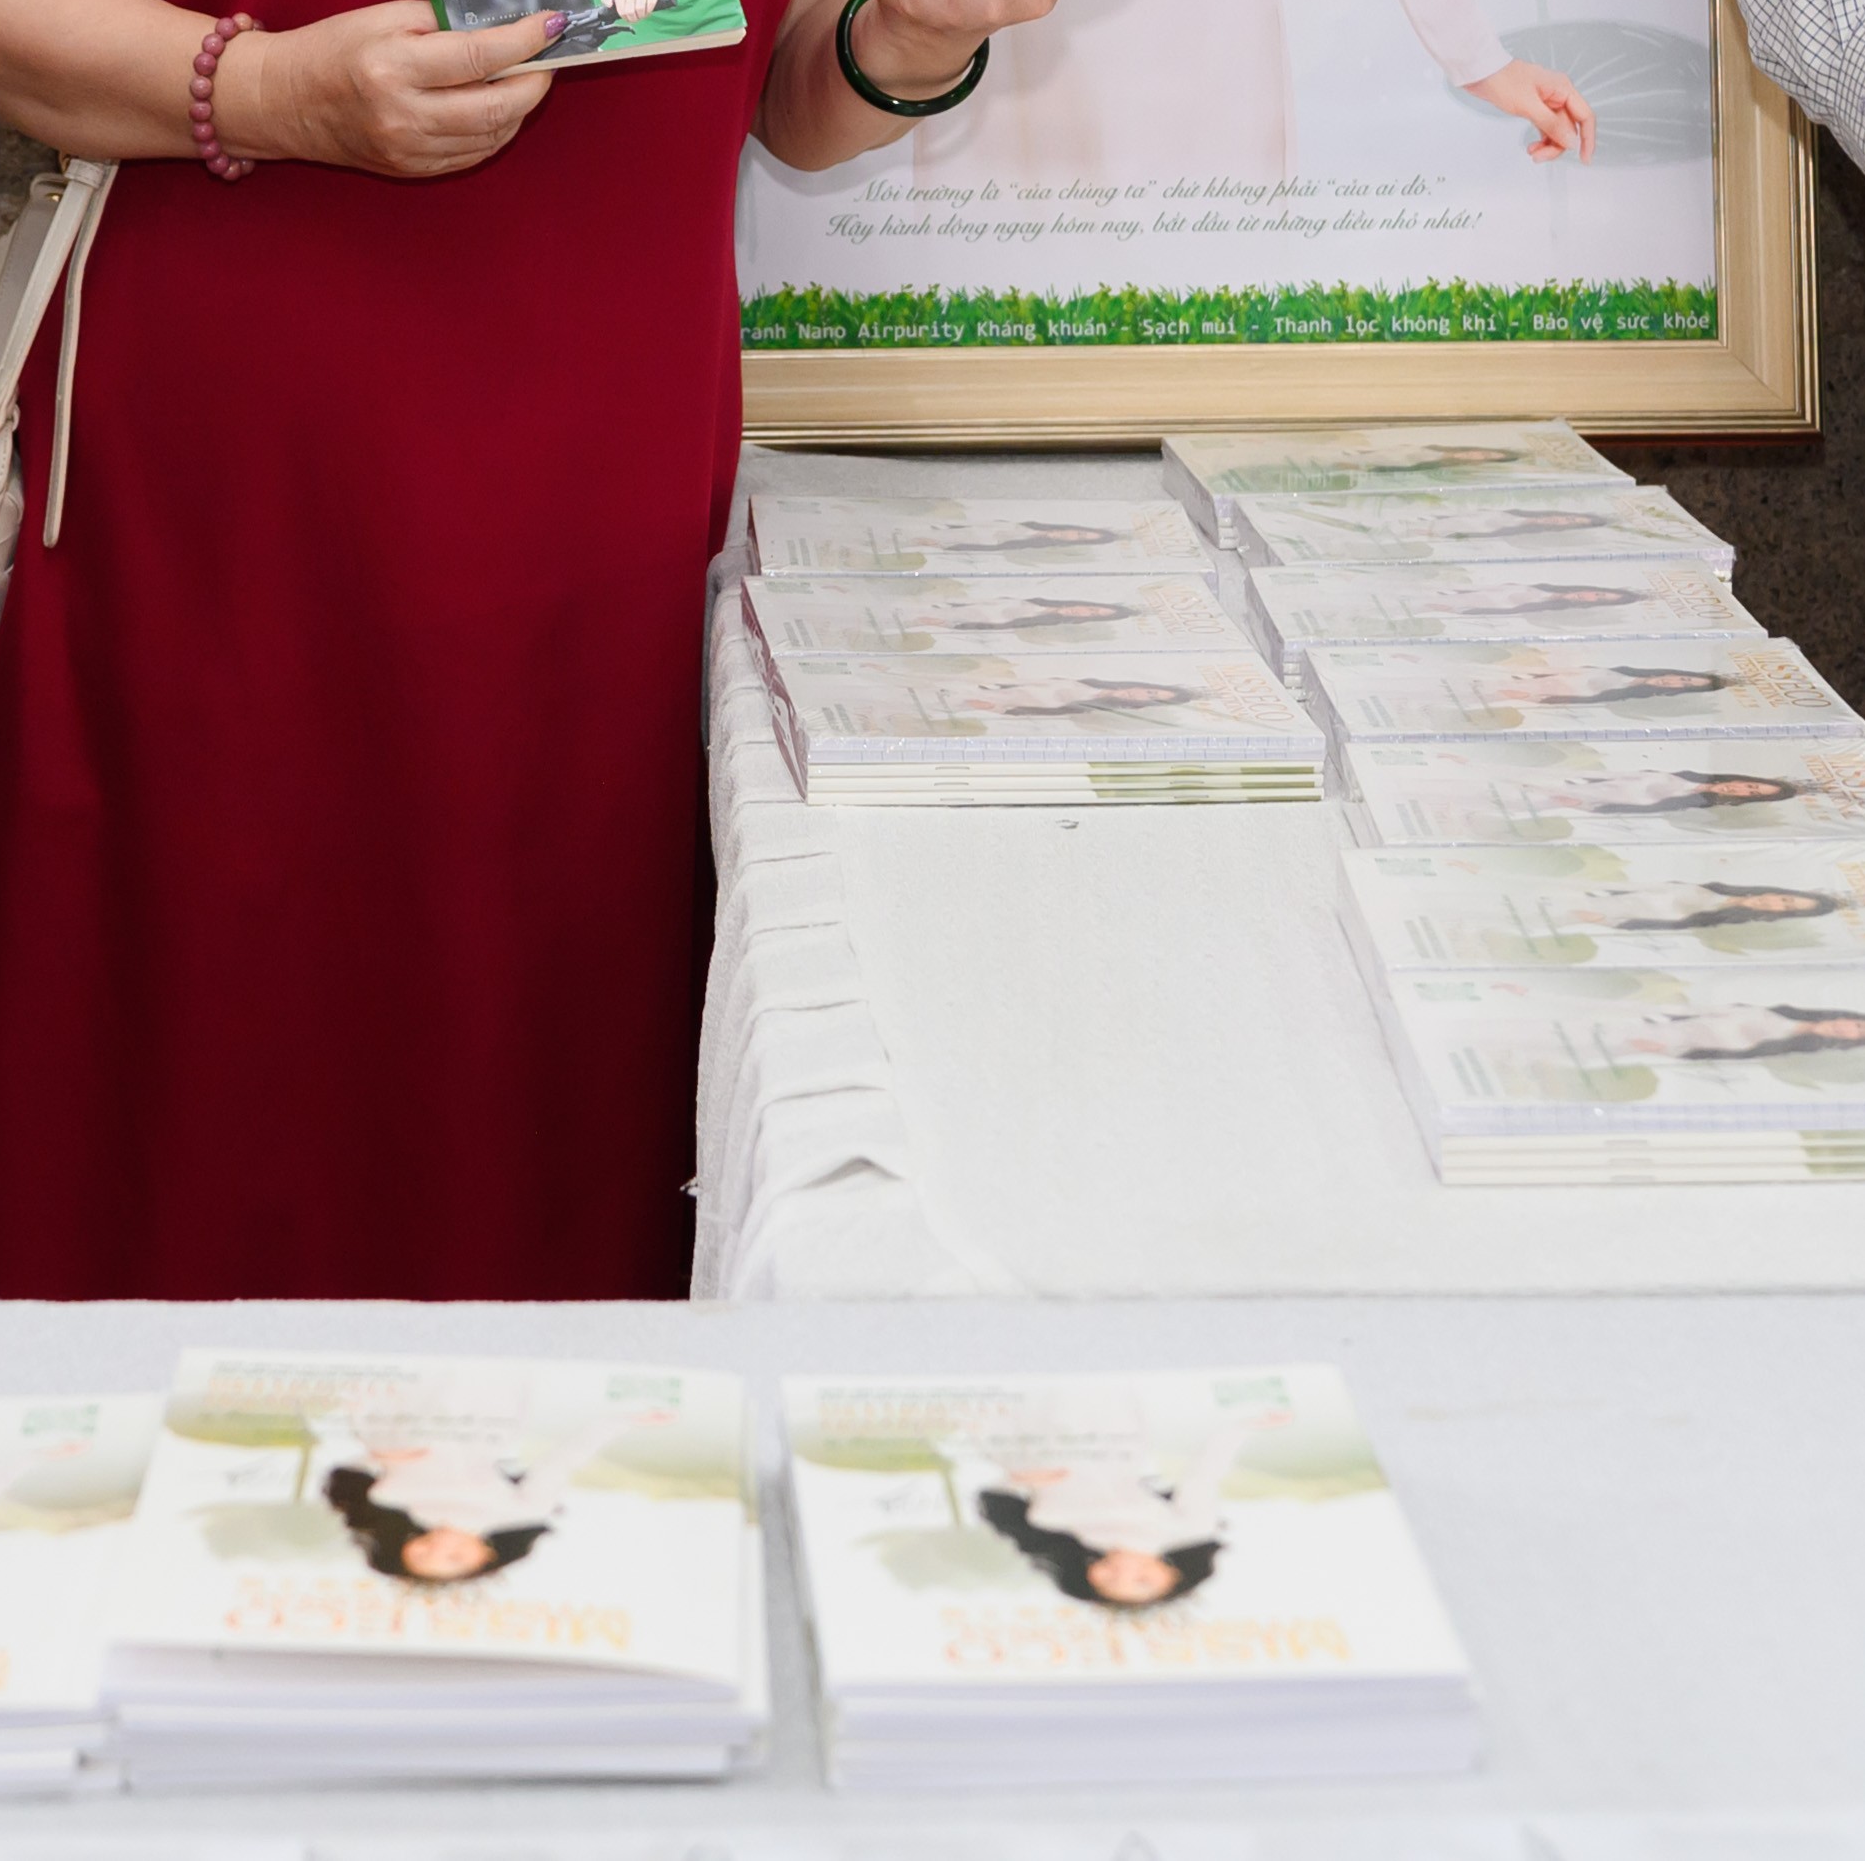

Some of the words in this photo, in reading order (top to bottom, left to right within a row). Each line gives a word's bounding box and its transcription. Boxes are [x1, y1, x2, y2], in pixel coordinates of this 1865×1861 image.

[853, 178, 903, 203] Môi
[905, 183, 975, 209] trường
[980, 178, 1001, 201] là
[1058, 177, 1120, 207] chúng
[1162, 176, 1201, 200] chứ
[1202, 175, 1267, 205] không
[1266, 175, 1320, 206] phải
[1375, 179, 1399, 197] ai
[878, 213, 932, 236] hành
[993, 220, 1046, 243] ngay
[1049, 211, 1096, 234] hôm
[1099, 220, 1145, 243] nay,
[1152, 210, 1188, 234] bắt
[1235, 214, 1261, 233] từ
[1261, 209, 1329, 239] những
[1378, 208, 1419, 231] nhỏ
[740, 323, 785, 339] ranh
[798, 323, 847, 339] Nano
[857, 321, 965, 341] Airpurity
[977, 319, 1036, 341] Kháng
[1047, 316, 1107, 337] khuẩn
[1142, 319, 1191, 339] Sạch
[1201, 316, 1236, 336] mùi
[1273, 316, 1333, 335] Thanh
[1345, 315, 1380, 337] lọc
[1391, 314, 1451, 335] không
[1462, 313, 1497, 332] khí
[1532, 313, 1569, 331] Bảo
[1580, 313, 1603, 333] vệ
[1616, 311, 1650, 330] sức
[1663, 311, 1710, 330] khỏe
